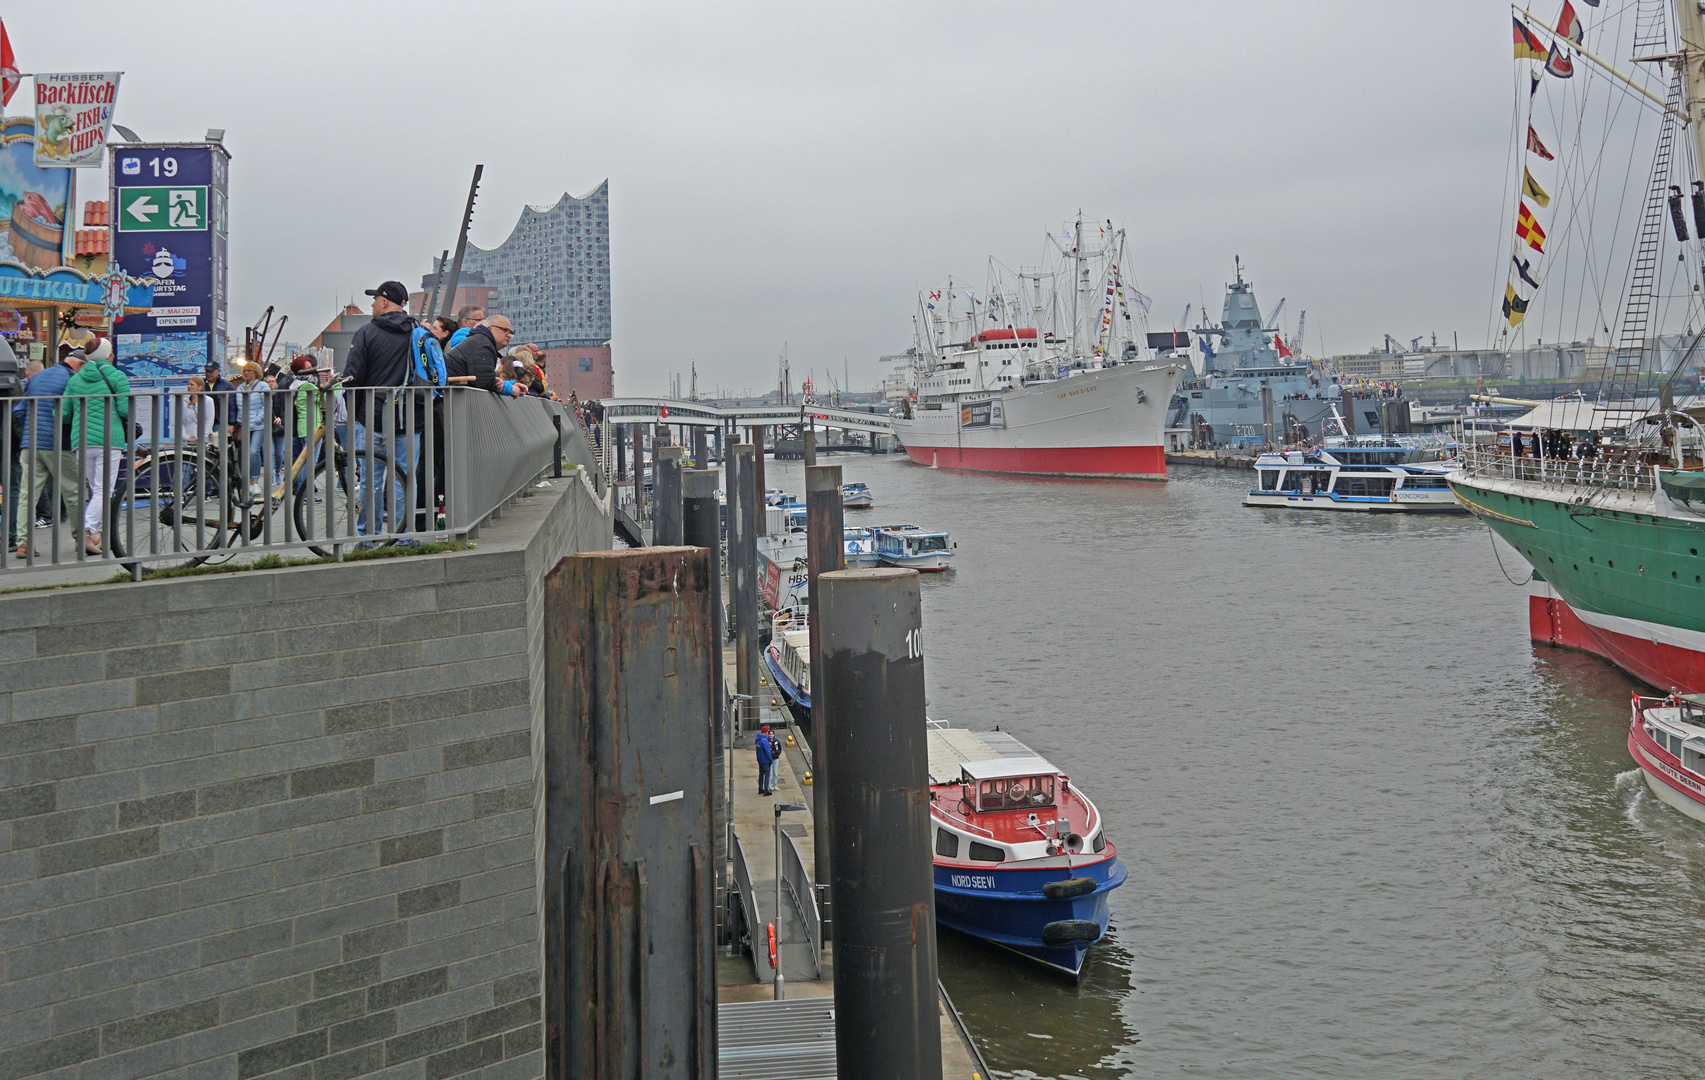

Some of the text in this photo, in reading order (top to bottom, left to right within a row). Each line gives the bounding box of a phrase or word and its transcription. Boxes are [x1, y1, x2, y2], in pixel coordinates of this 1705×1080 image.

[49, 74, 105, 82] HEISSER
[36, 81, 115, 105] Backfisch
[76, 106, 109, 132] FISH &
[70, 126, 104, 154] CHIPS
[149, 157, 178, 177] 19
[1057, 385, 1098, 400] CAP SAN DIEGO
[905, 627, 923, 659] 10
[1659, 762, 1702, 792] SEUTE DEERN
[951, 874, 996, 889] NORD SEE VI
